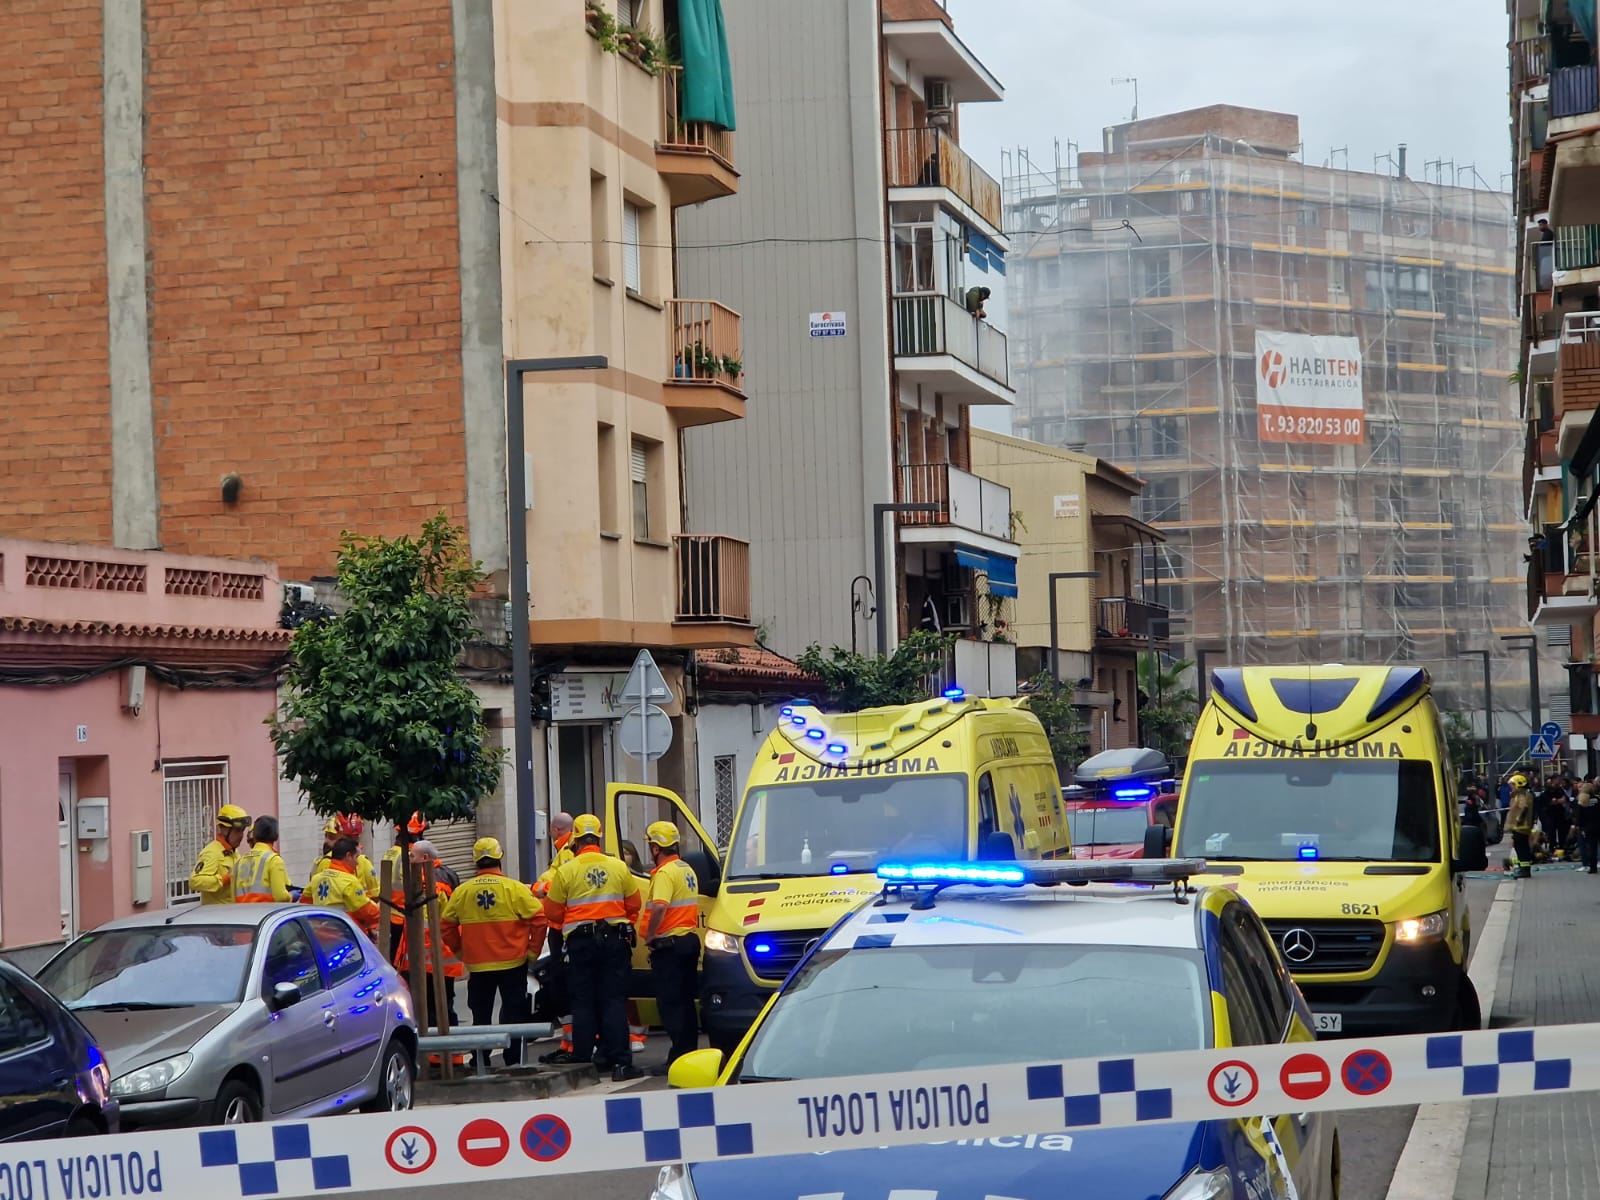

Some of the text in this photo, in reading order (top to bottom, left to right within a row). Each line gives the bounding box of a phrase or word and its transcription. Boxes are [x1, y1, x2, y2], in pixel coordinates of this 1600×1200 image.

[1290, 356, 1358, 377] HABITEN
[1262, 413, 1361, 436] T. 93 820 53 00
[78, 727, 87, 740] 18
[1341, 903, 1380, 916] 8621
[797, 1082, 989, 1138] POLICIA LOCAL
[57, 1150, 162, 1200] POLICIA
